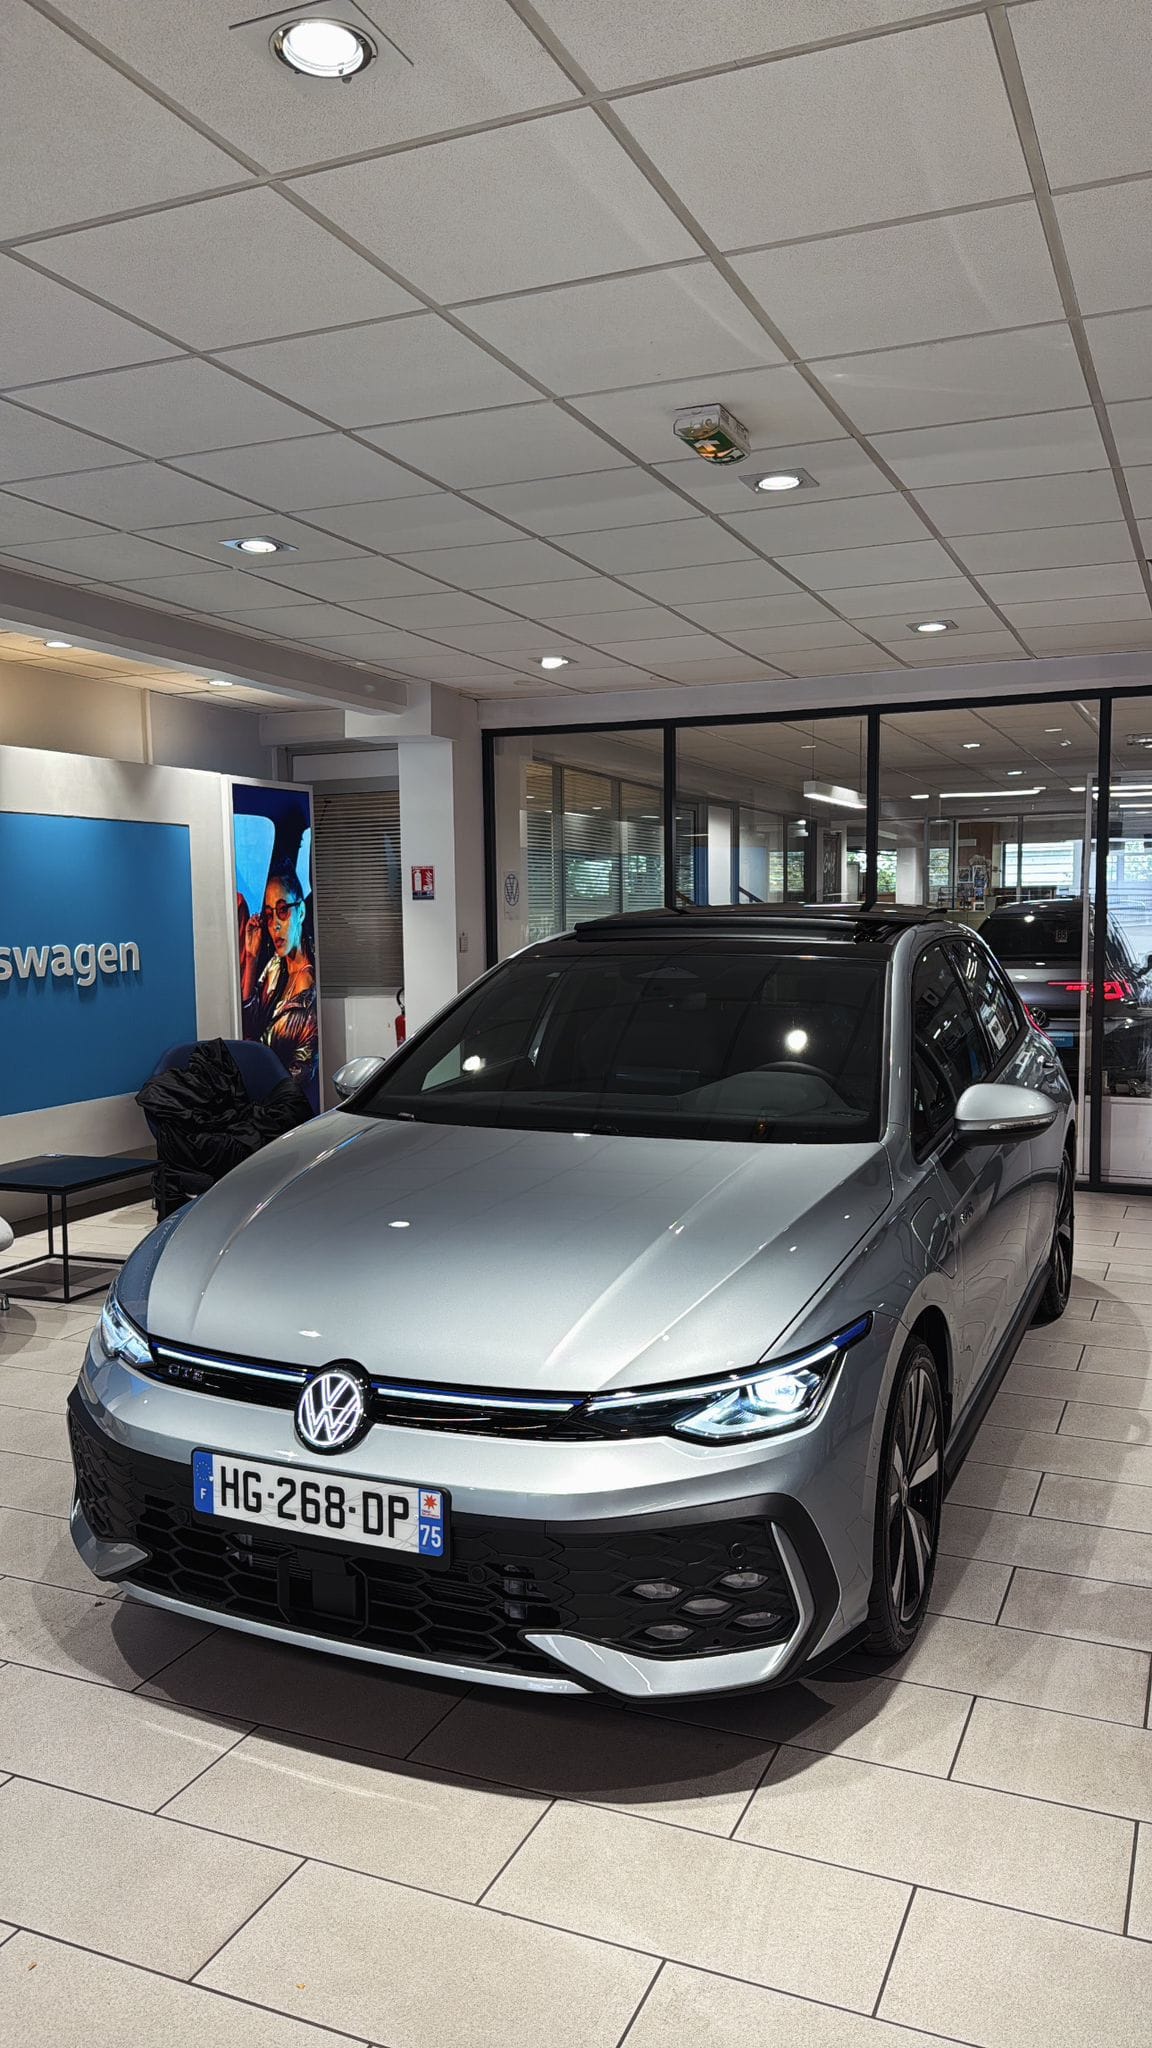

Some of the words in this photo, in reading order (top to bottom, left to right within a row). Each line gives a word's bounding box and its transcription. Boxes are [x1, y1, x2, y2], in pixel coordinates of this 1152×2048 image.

[0, 941, 140, 986] swagen
[298, 1372, 361, 1447] VW
[200, 1487, 208, 1500] F
[220, 1465, 410, 1539] HG-268-DP
[420, 1524, 442, 1549] 75
